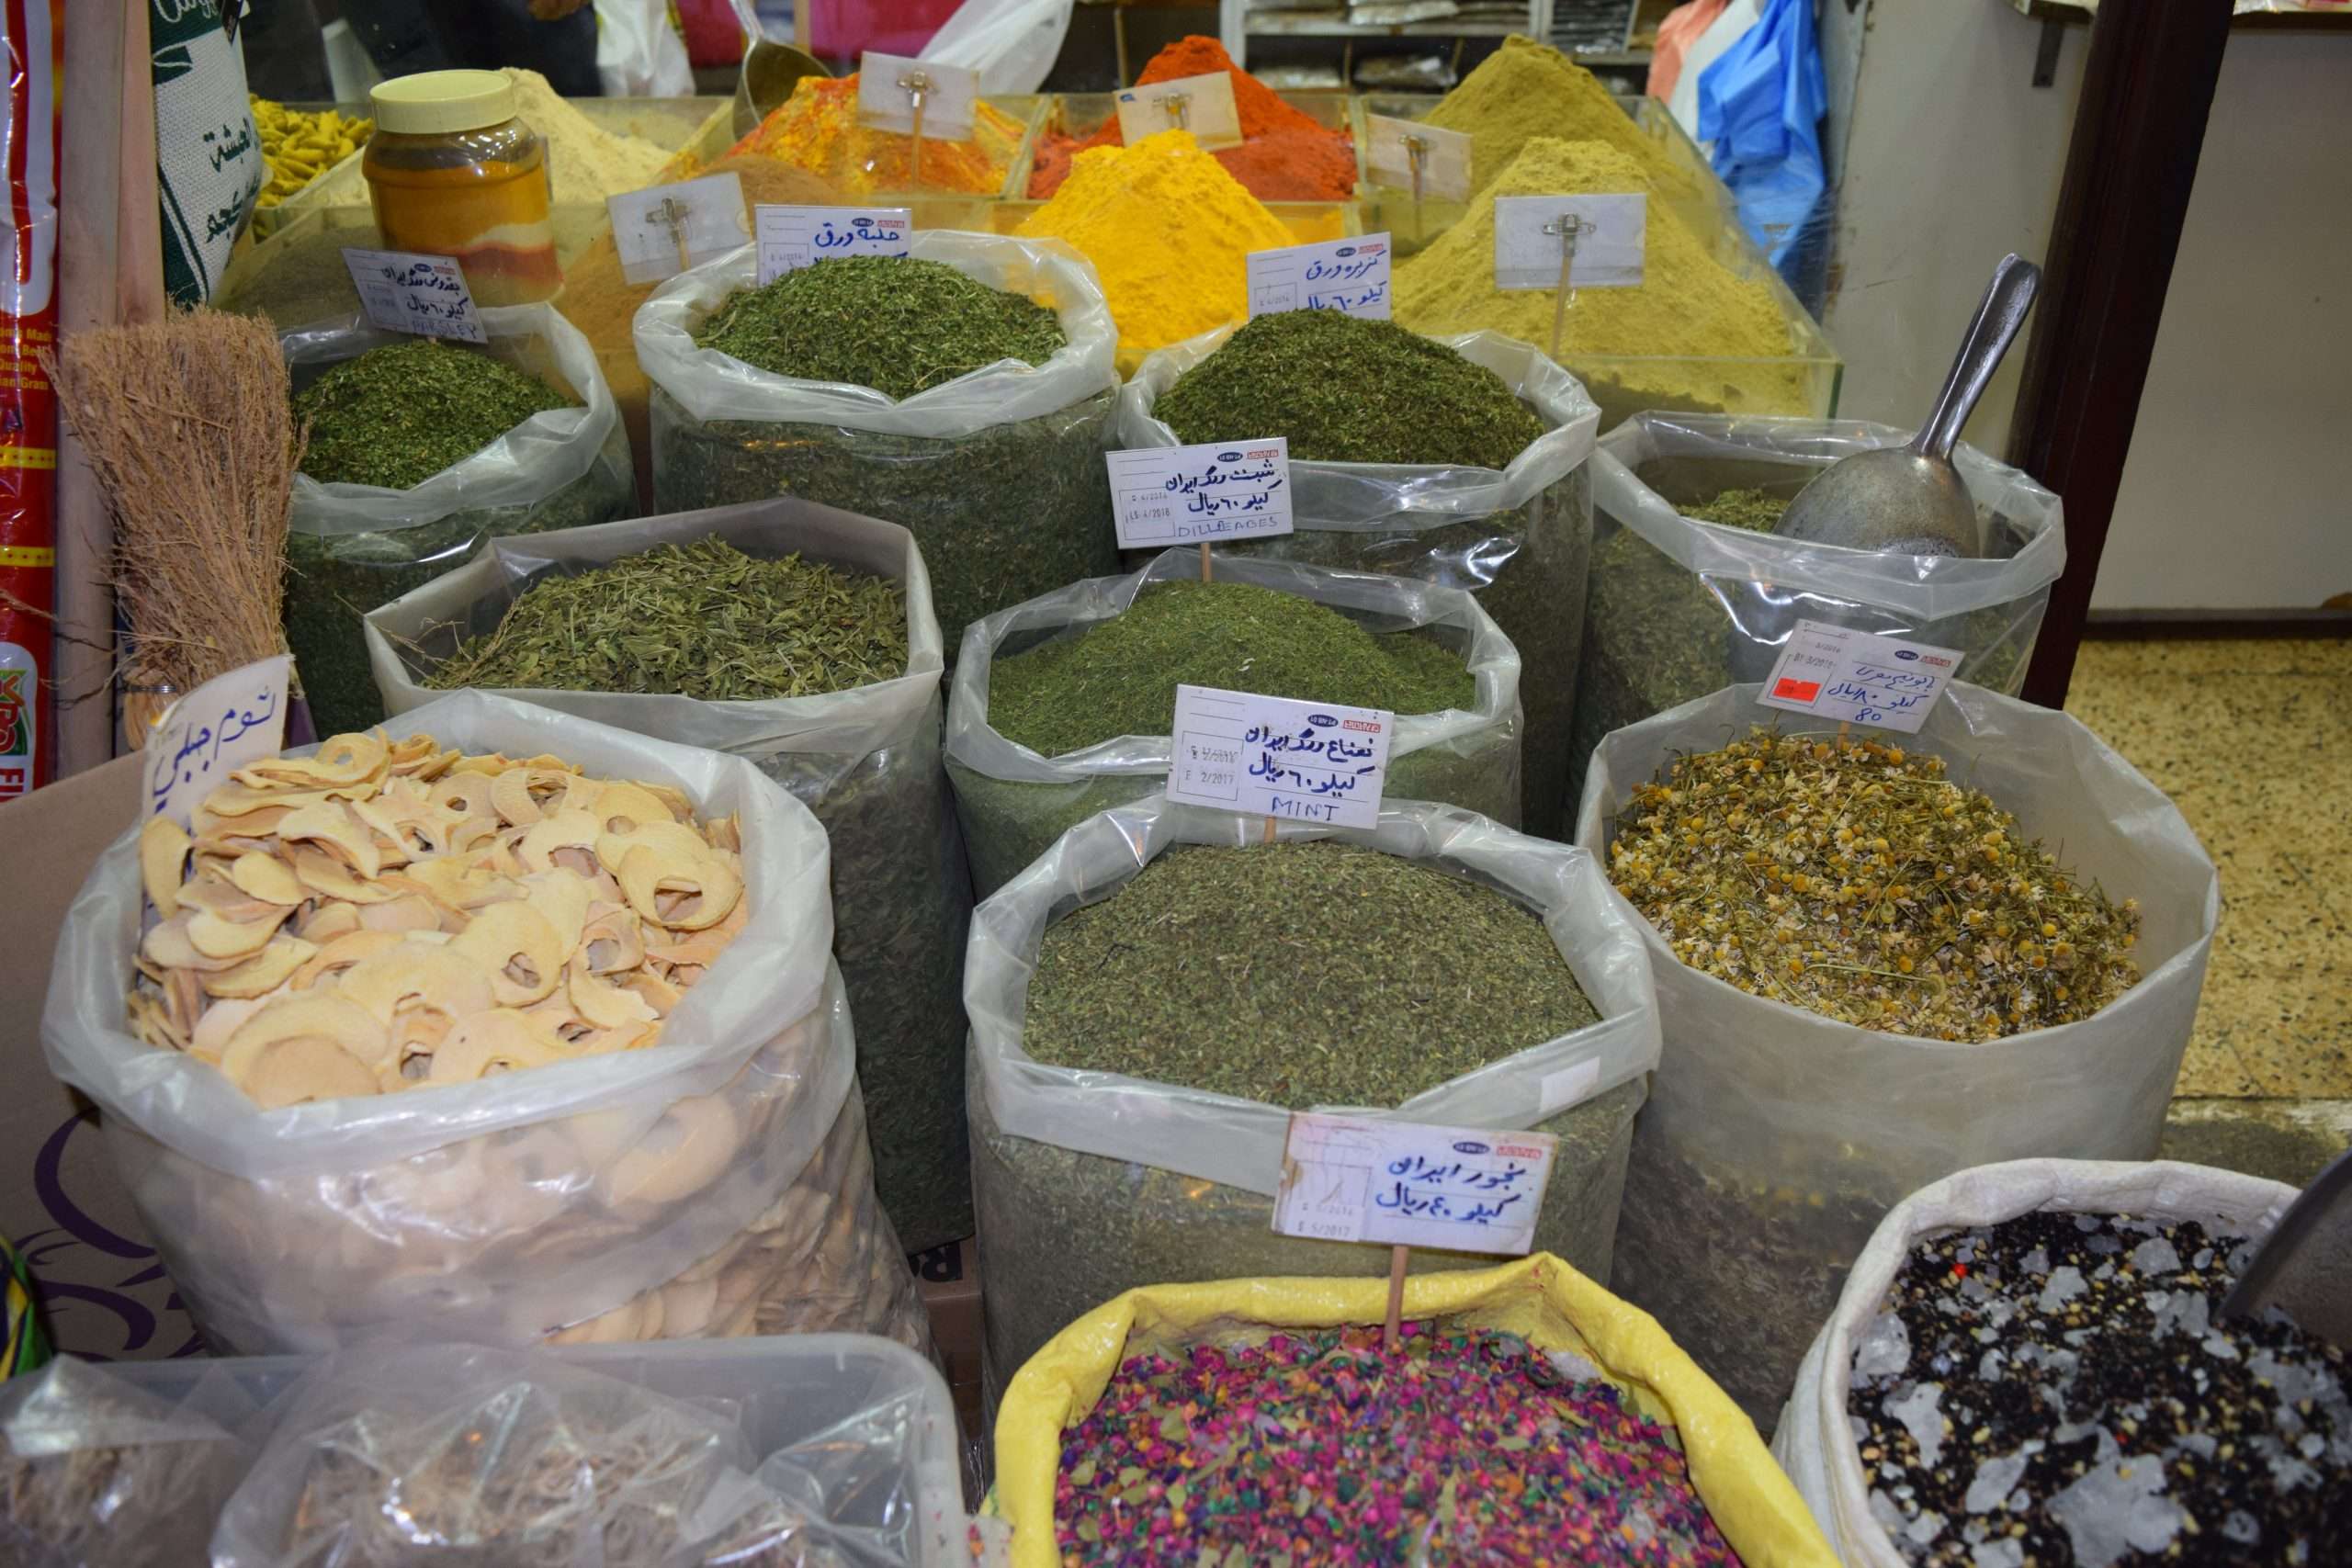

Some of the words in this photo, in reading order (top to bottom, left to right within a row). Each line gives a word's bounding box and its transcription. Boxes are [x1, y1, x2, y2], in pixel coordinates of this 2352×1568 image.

[1188, 492, 1220, 515] ريال
[1855, 707, 1882, 722] 80
[1250, 751, 1284, 783] ريال
[1272, 796, 1340, 821] MINT
[1375, 1181, 1429, 1215] ريال
[1454, 1194, 1521, 1224] كيلو
